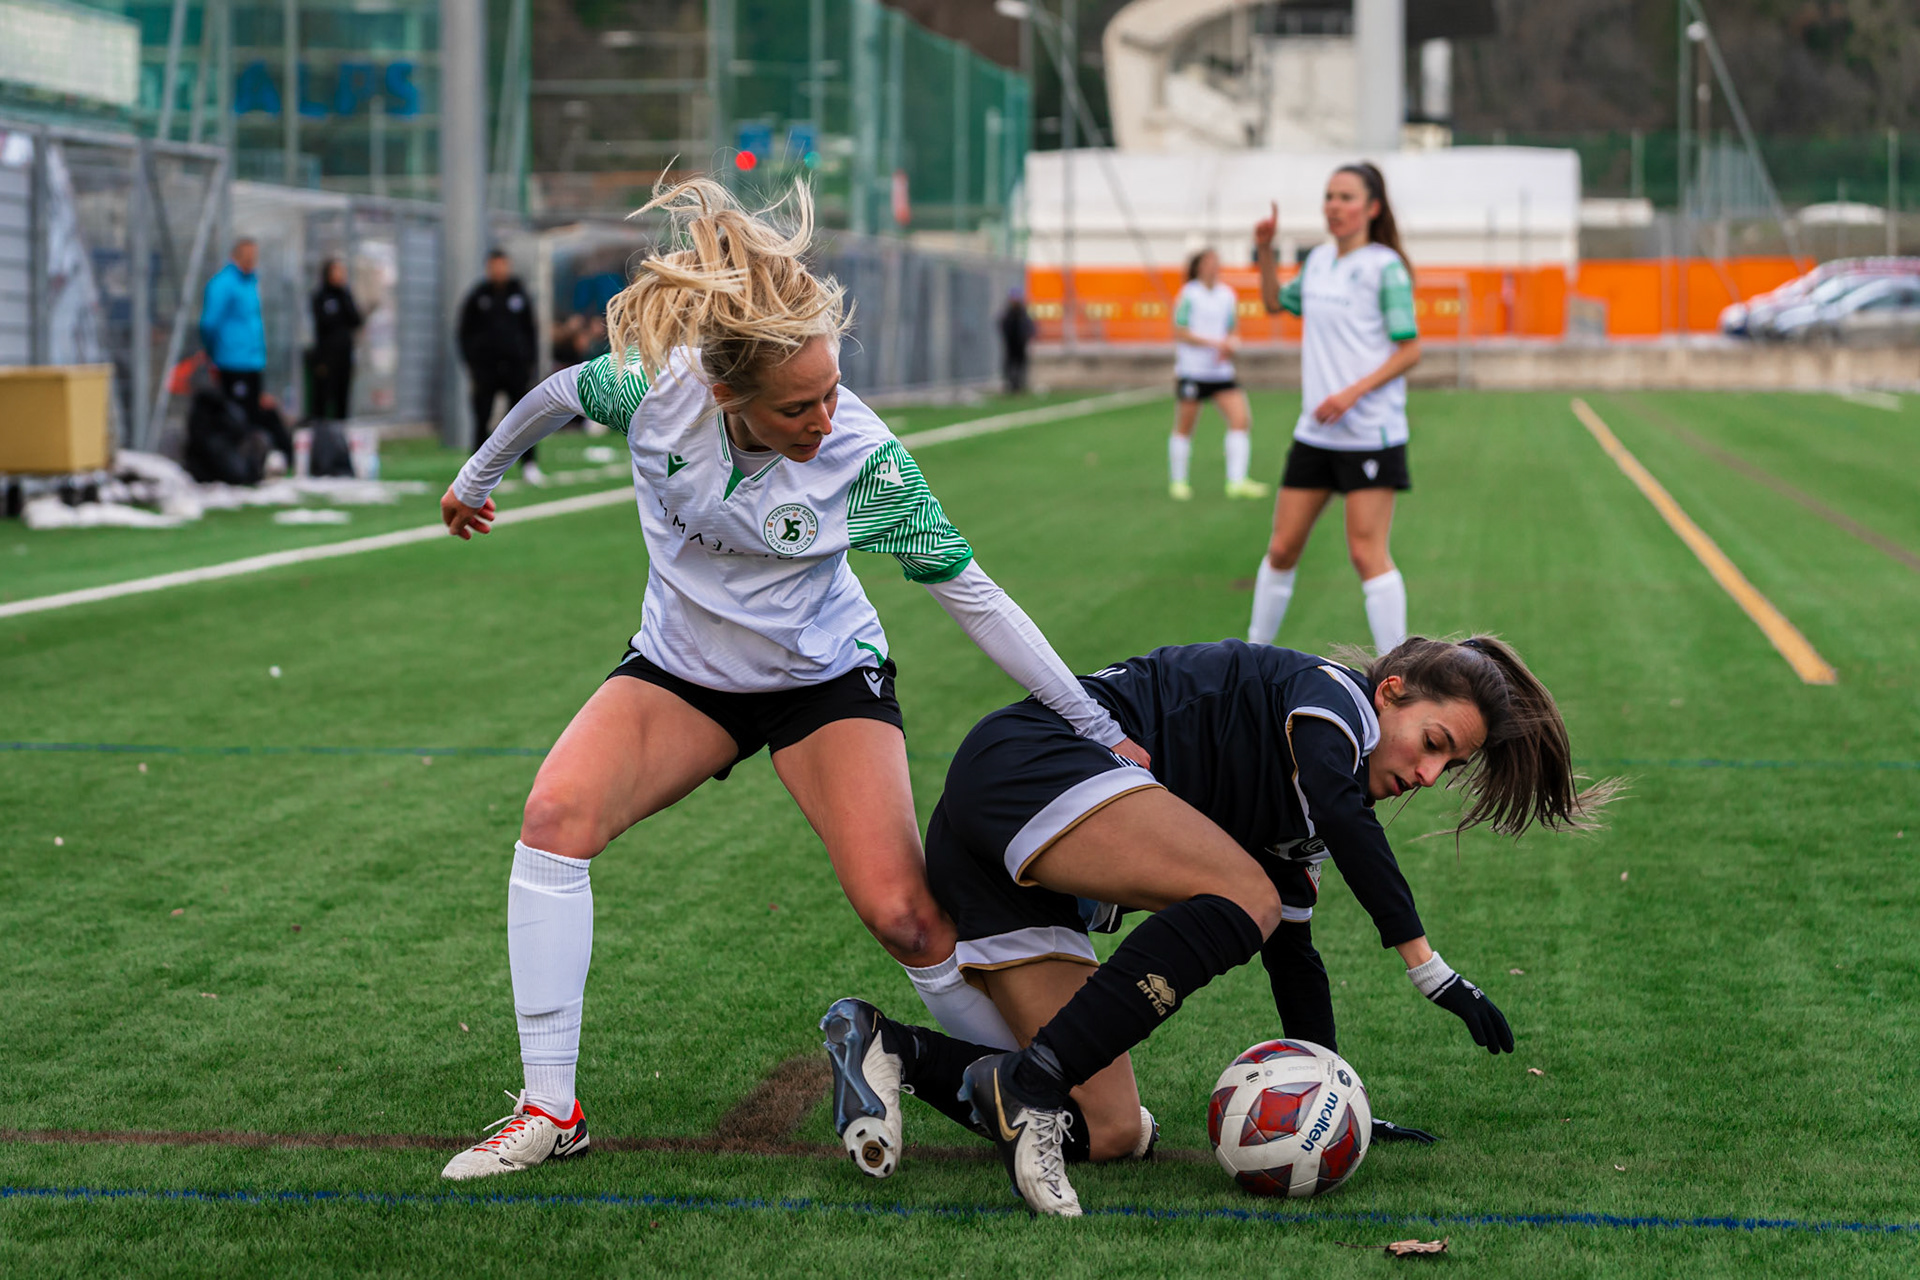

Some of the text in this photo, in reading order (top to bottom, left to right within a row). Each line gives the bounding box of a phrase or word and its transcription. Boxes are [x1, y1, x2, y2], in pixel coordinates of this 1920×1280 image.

[234, 60, 420, 117] ALPS
[770, 506, 815, 527] YVERDON SPORT
[767, 530, 811, 552] FOOTBALL CLUB
[1300, 1091, 1339, 1152] molten
